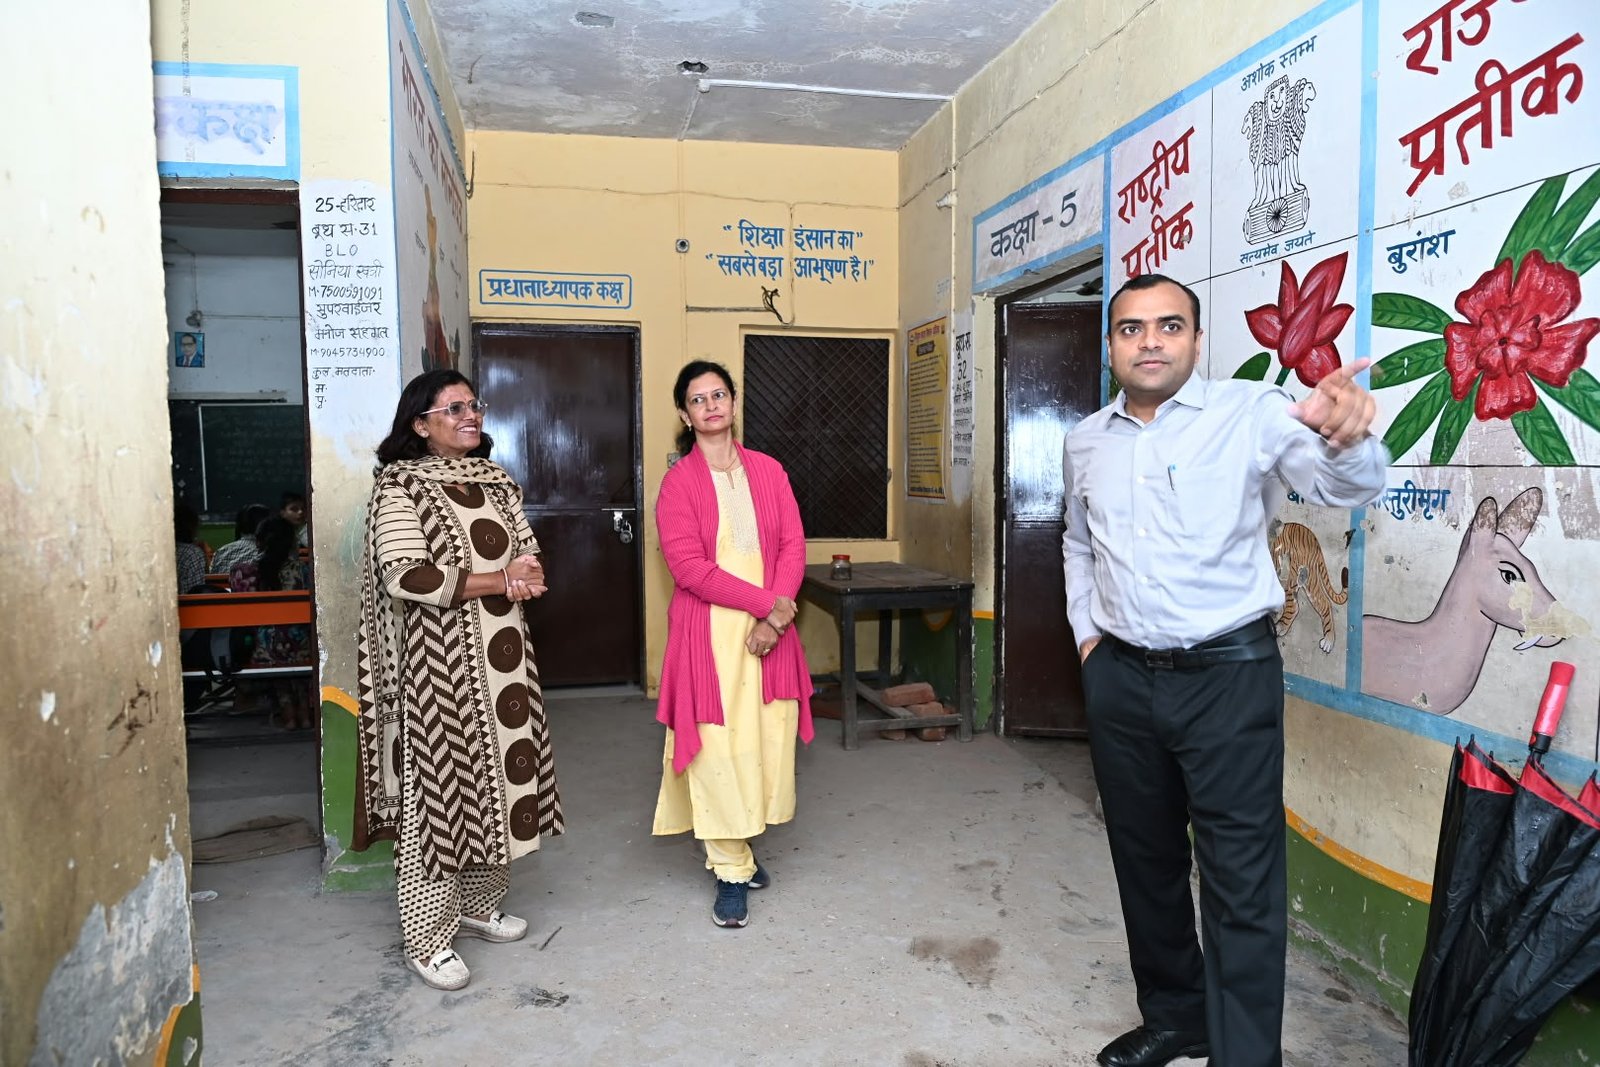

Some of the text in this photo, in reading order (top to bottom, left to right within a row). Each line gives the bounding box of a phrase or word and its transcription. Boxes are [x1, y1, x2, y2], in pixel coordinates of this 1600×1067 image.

[1241, 60, 1275, 91] अशोक
[1399, 32, 1584, 197] प्रतीक
[1118, 126, 1194, 223] राष्ट्रीय
[793, 225, 836, 250] इंसान
[990, 210, 1040, 257] कक्षा
[1059, 189, 1077, 228] 5
[1240, 230, 1316, 264] सत्यमेव जयते
[1386, 229, 1456, 274] बुरांश
[758, 256, 784, 280] बड़ा
[794, 257, 848, 284] आभूषण
[486, 278, 624, 304] प्रधानाध्यापक कक्ष
[314, 324, 347, 340] मनोज
[312, 366, 332, 380] कुल
